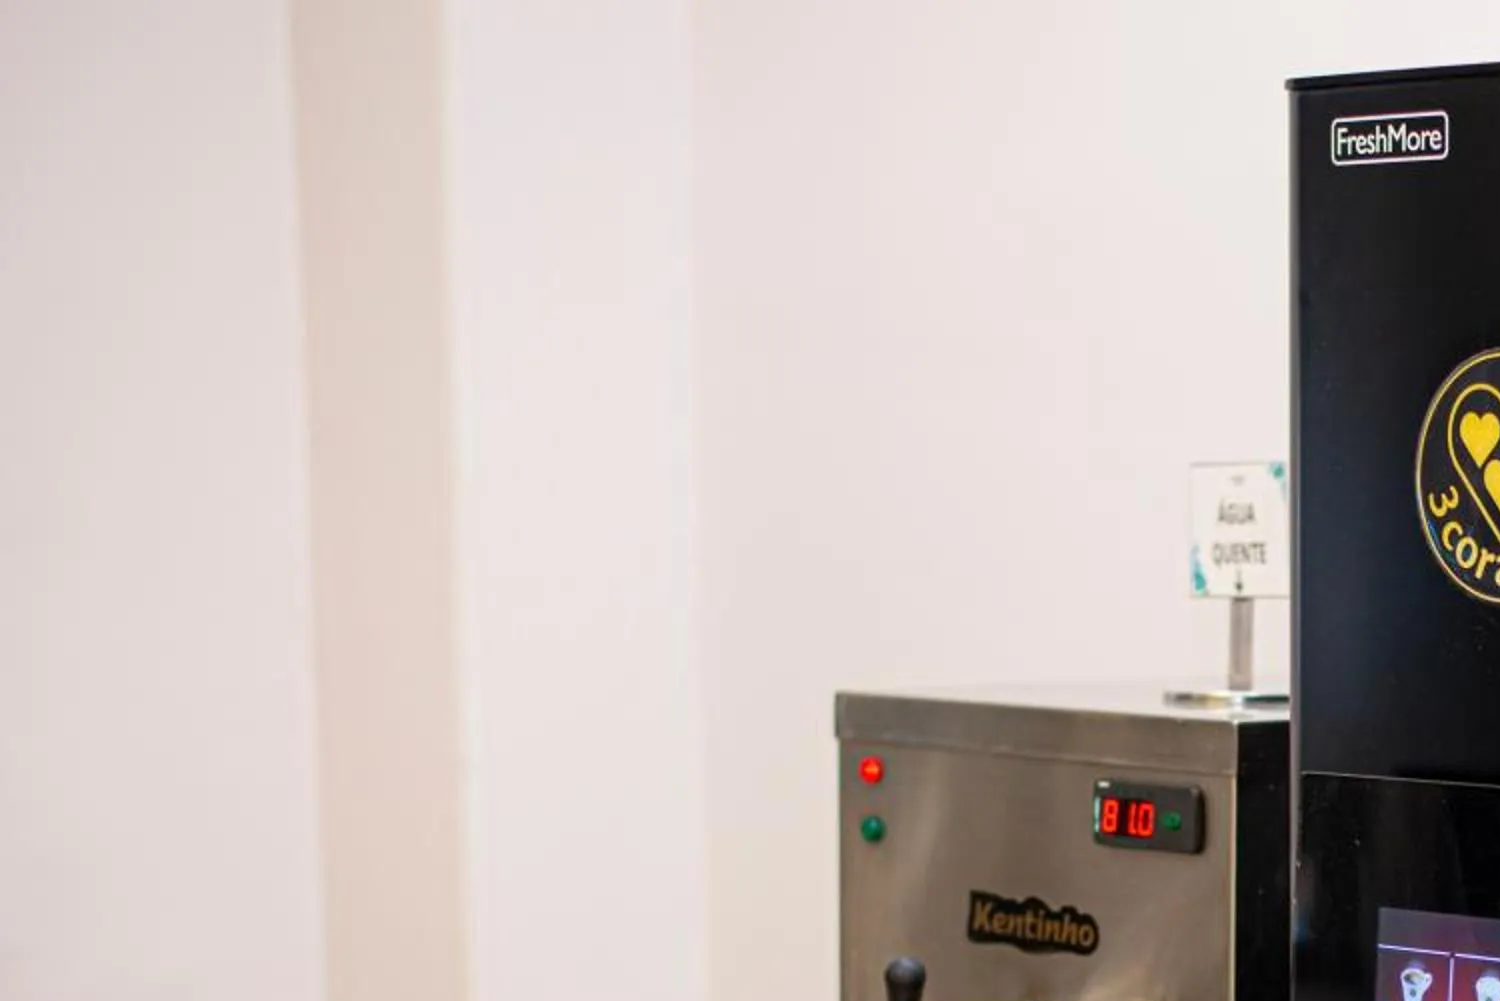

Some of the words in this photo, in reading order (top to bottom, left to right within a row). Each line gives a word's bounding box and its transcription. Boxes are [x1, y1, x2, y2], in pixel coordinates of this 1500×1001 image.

[1337, 123, 1442, 156] FreshMore
[1428, 485, 1460, 518] 3
[1212, 542, 1267, 569] QUENTE
[972, 901, 1094, 947] Kentinho
